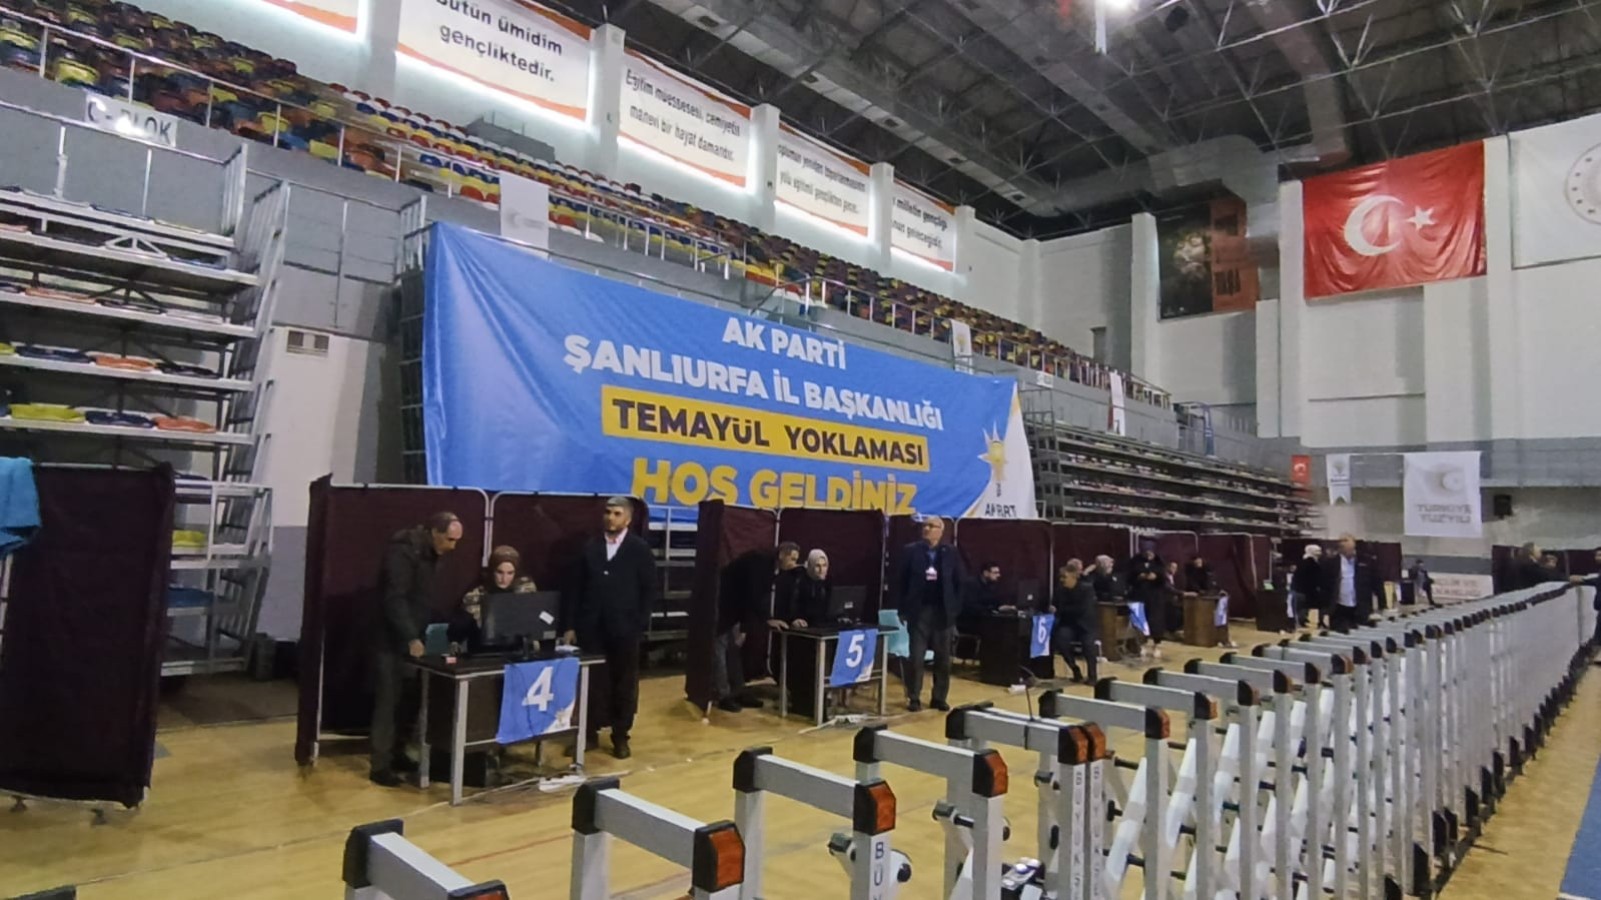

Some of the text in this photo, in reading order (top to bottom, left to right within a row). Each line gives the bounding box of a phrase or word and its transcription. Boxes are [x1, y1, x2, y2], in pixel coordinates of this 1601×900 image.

[436, 0, 562, 55] ütün ümidim
[440, 24, 555, 82] gençliktedir.
[722, 317, 847, 370] AK PARTİ
[563, 334, 944, 431] ŞANLIURFA İL BAŞKANLIĞI
[612, 398, 924, 466] TEMAYÜL YOKLAMASI
[750, 469, 917, 514] GELDİNİZ
[845, 634, 866, 668] 5
[1037, 616, 1047, 644] 6
[521, 666, 554, 712] 4
